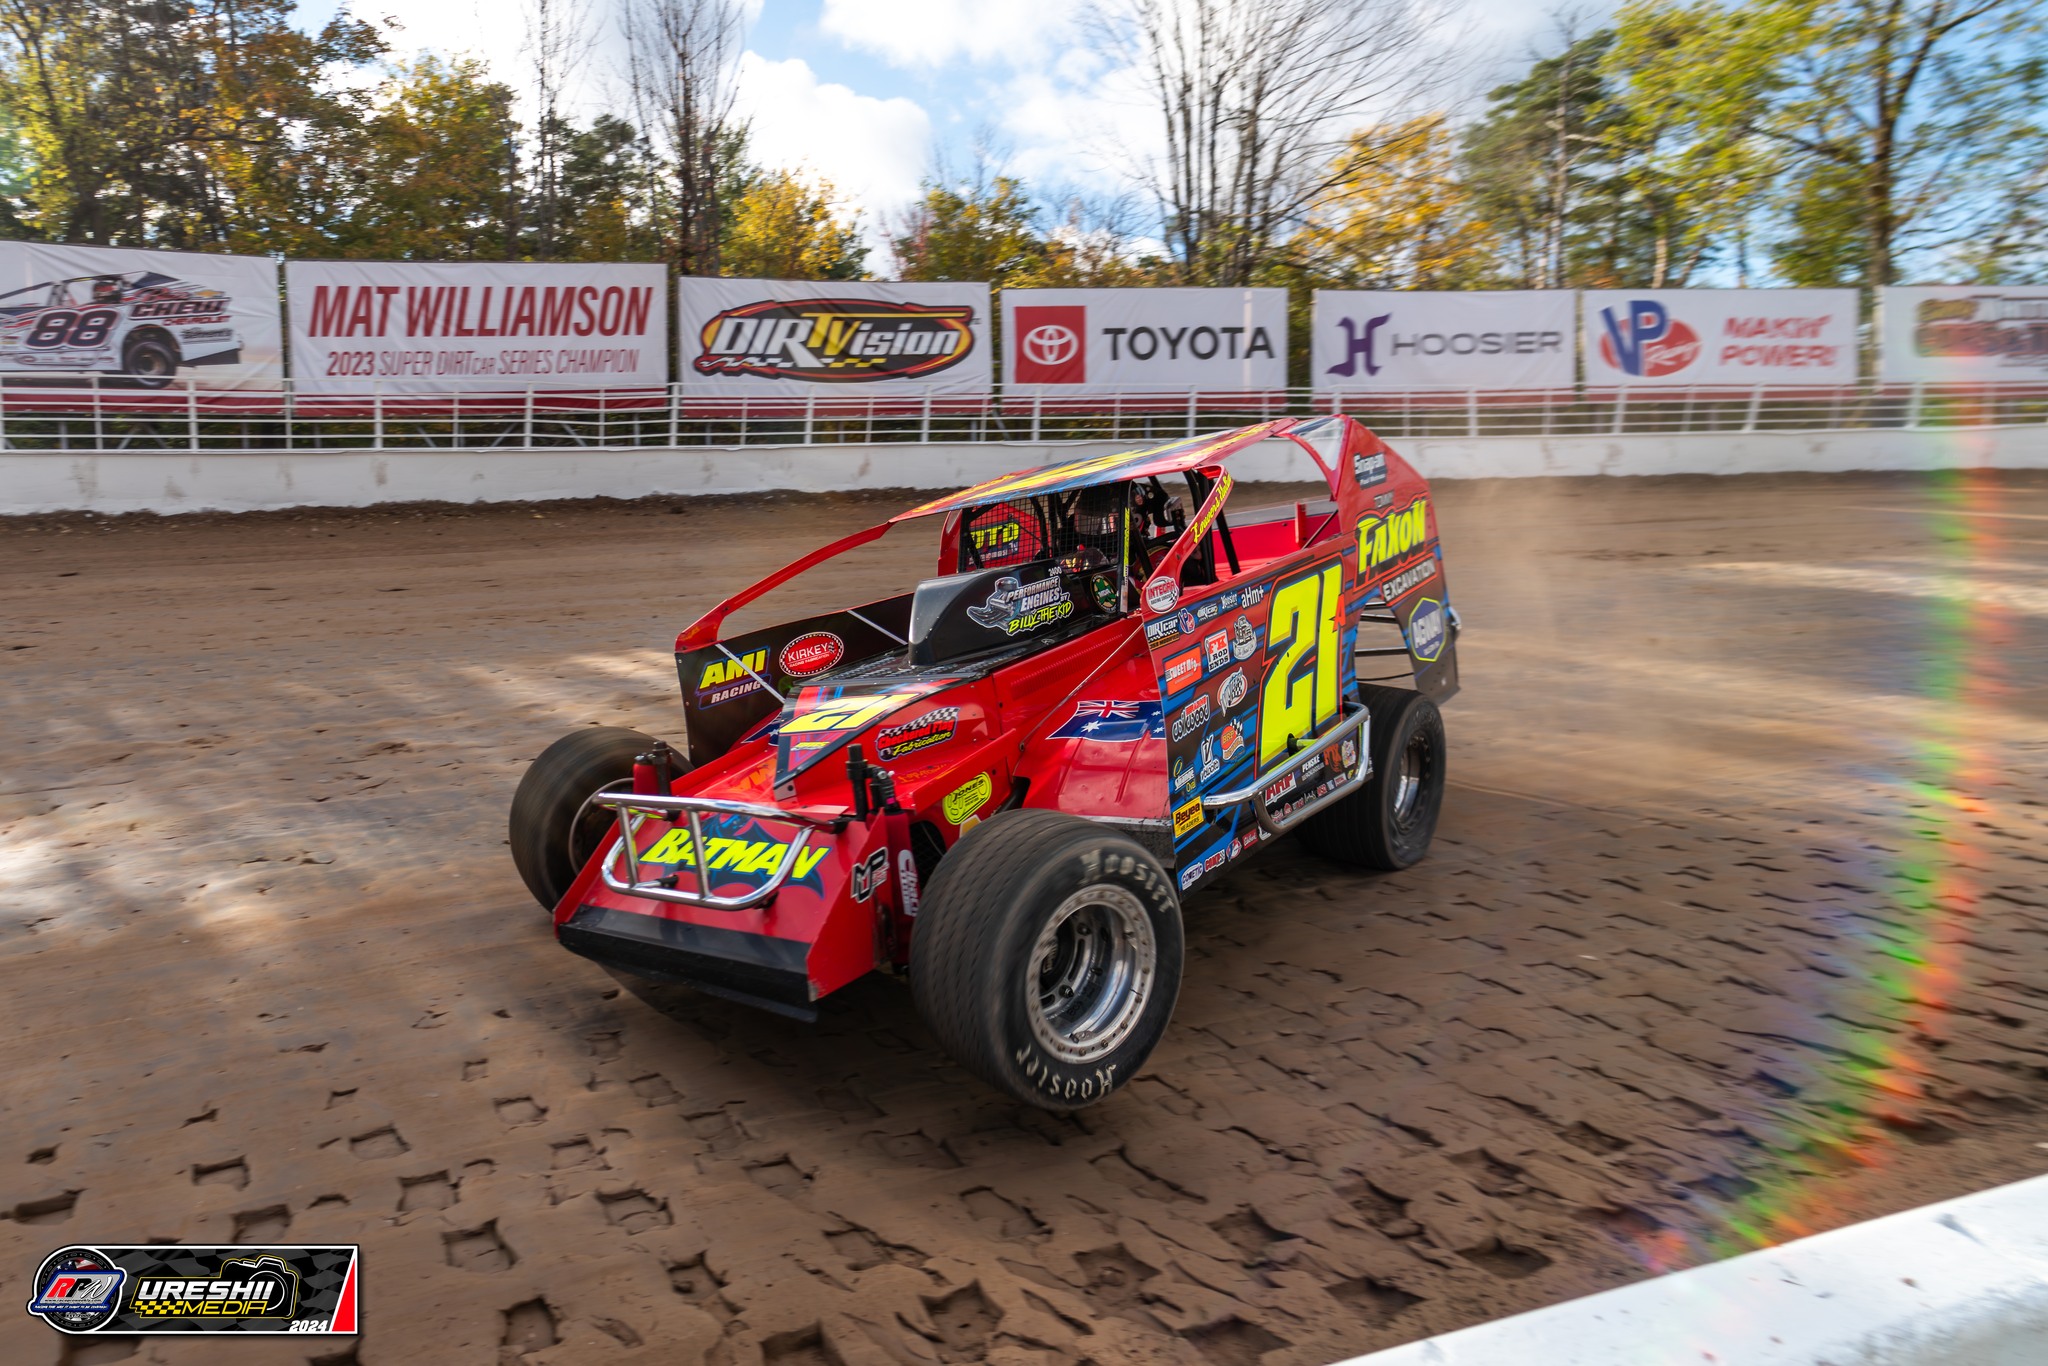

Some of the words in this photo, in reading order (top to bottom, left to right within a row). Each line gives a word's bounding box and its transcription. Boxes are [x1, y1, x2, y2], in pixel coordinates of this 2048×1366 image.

[309, 286, 400, 337] MAT
[406, 286, 654, 337] WILLIAMSON
[26, 309, 118, 348] 88
[1599, 300, 1668, 377] VP
[1103, 326, 1276, 361] TOYOTA
[1390, 331, 1563, 357] HOOSIER
[326, 351, 375, 376] 2023
[378, 350, 433, 376] SUPER
[498, 350, 552, 375] SERIES
[555, 349, 641, 374] CHAMPION
[1356, 500, 1427, 575] FAXON
[1006, 577, 1060, 603] PERFORMANCE
[1382, 557, 1437, 601] EXCAVATION
[1020, 587, 1061, 612] ENGINES
[1008, 614, 1040, 634] BILLY
[1037, 605, 1058, 622] THE
[1057, 601, 1073, 616] KID
[787, 642, 829, 662] KIRKEY
[1209, 635, 1228, 655] FK
[1212, 648, 1228, 661] ROD
[700, 649, 766, 689] AMI
[1209, 656, 1229, 671] ENDS
[1260, 563, 1343, 768] 21
[711, 680, 762, 704] RACING
[878, 723, 931, 749] Checkered
[893, 731, 953, 756] Fabrication
[952, 778, 985, 803] JONES
[1175, 802, 1201, 826] Beyea
[1180, 816, 1200, 833] HEADERS
[640, 827, 830, 879] BATMAN
